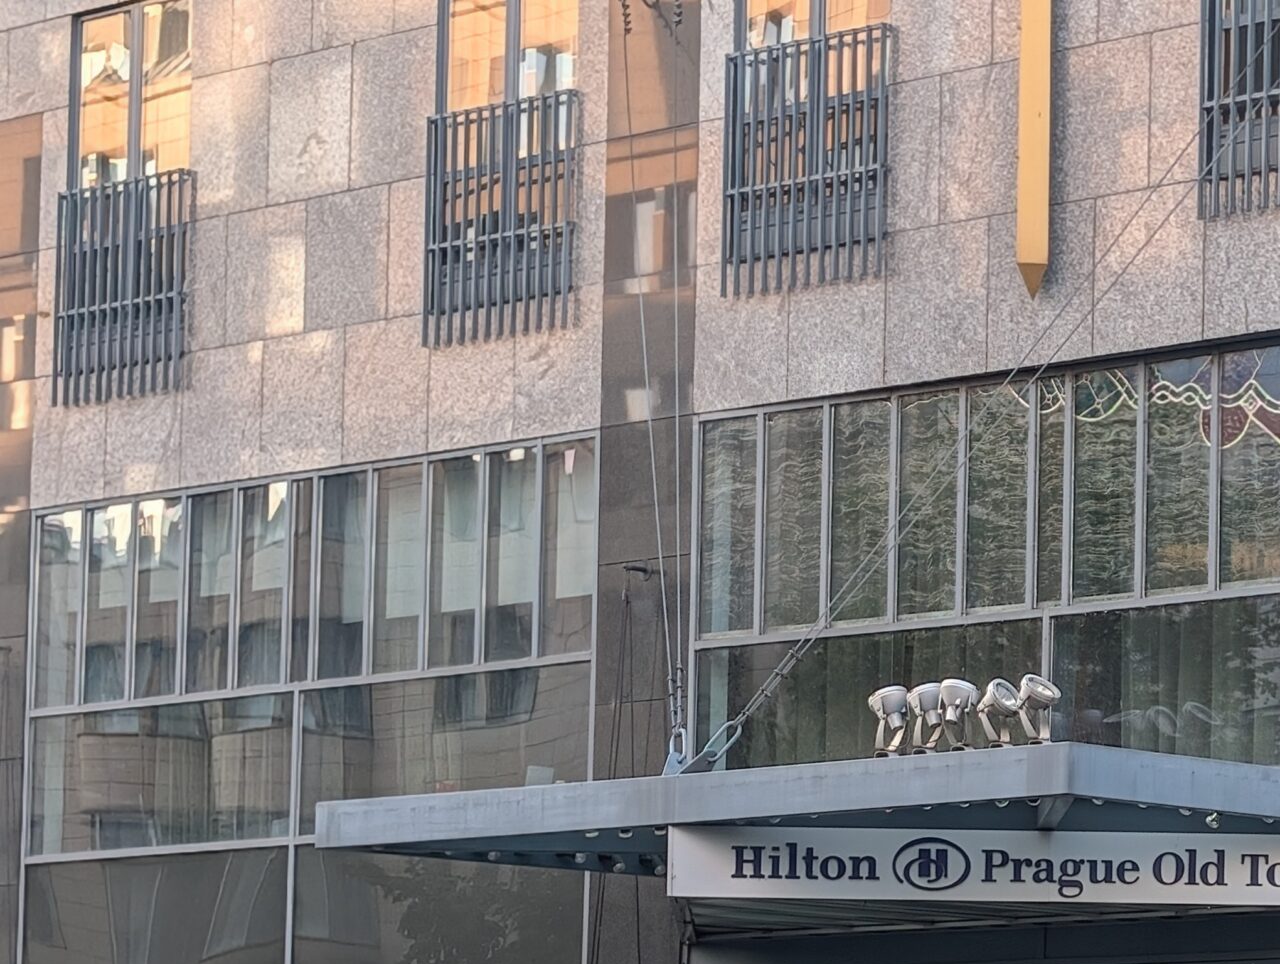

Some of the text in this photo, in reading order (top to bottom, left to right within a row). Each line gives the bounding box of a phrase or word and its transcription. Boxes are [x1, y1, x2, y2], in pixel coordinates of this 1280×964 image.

[731, 842, 880, 880] Hilton
[981, 850, 1140, 898] Prague
[1153, 849, 1228, 887] Old
